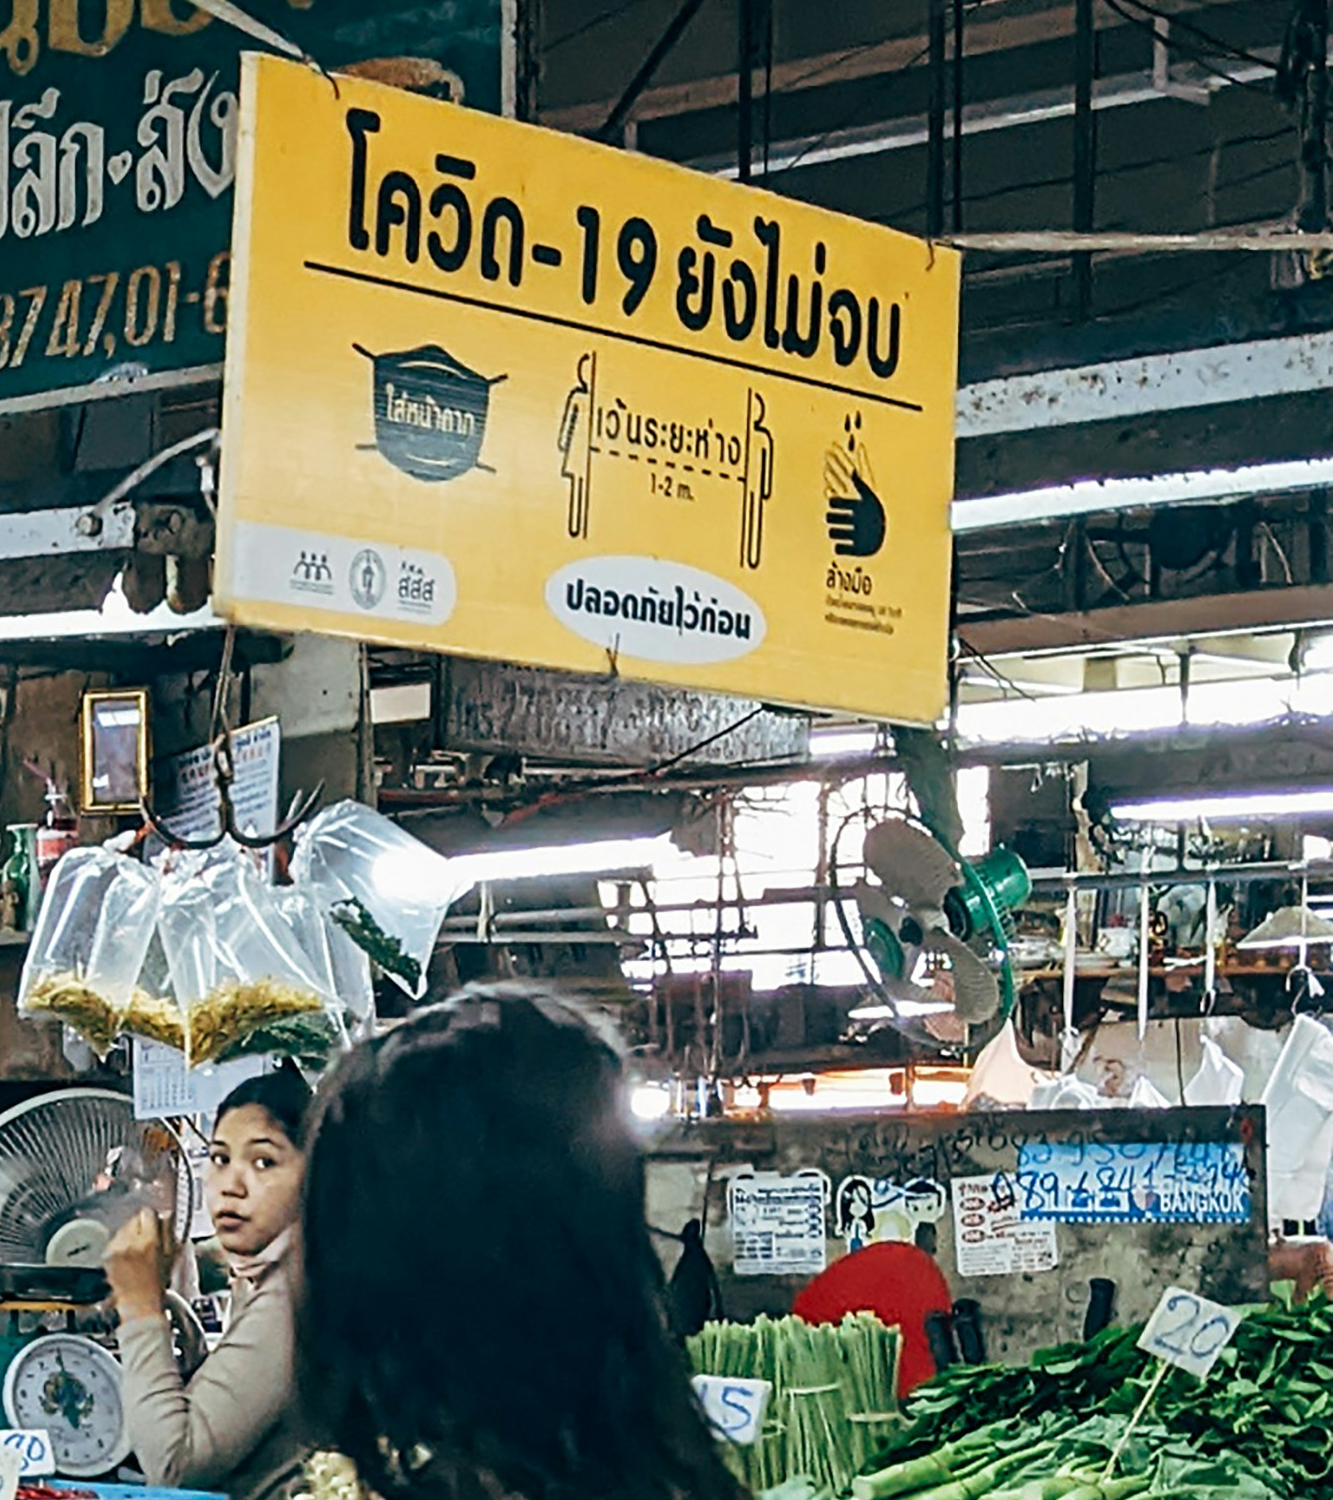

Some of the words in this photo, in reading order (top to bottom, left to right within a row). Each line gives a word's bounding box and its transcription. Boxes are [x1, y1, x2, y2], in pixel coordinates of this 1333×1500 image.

[676, 213, 902, 380] ยังไม่จบ
[386, 382, 475, 437] ใส่หน้ากาก
[596, 398, 741, 466] เว้นระยะห่าง
[565, 576, 753, 641] ปลอดภัยไว้ก่อน
[825, 560, 873, 596] ล้างมือ
[1160, 1189, 1245, 1213] BANGKOK
[1151, 1294, 1231, 1358] 20
